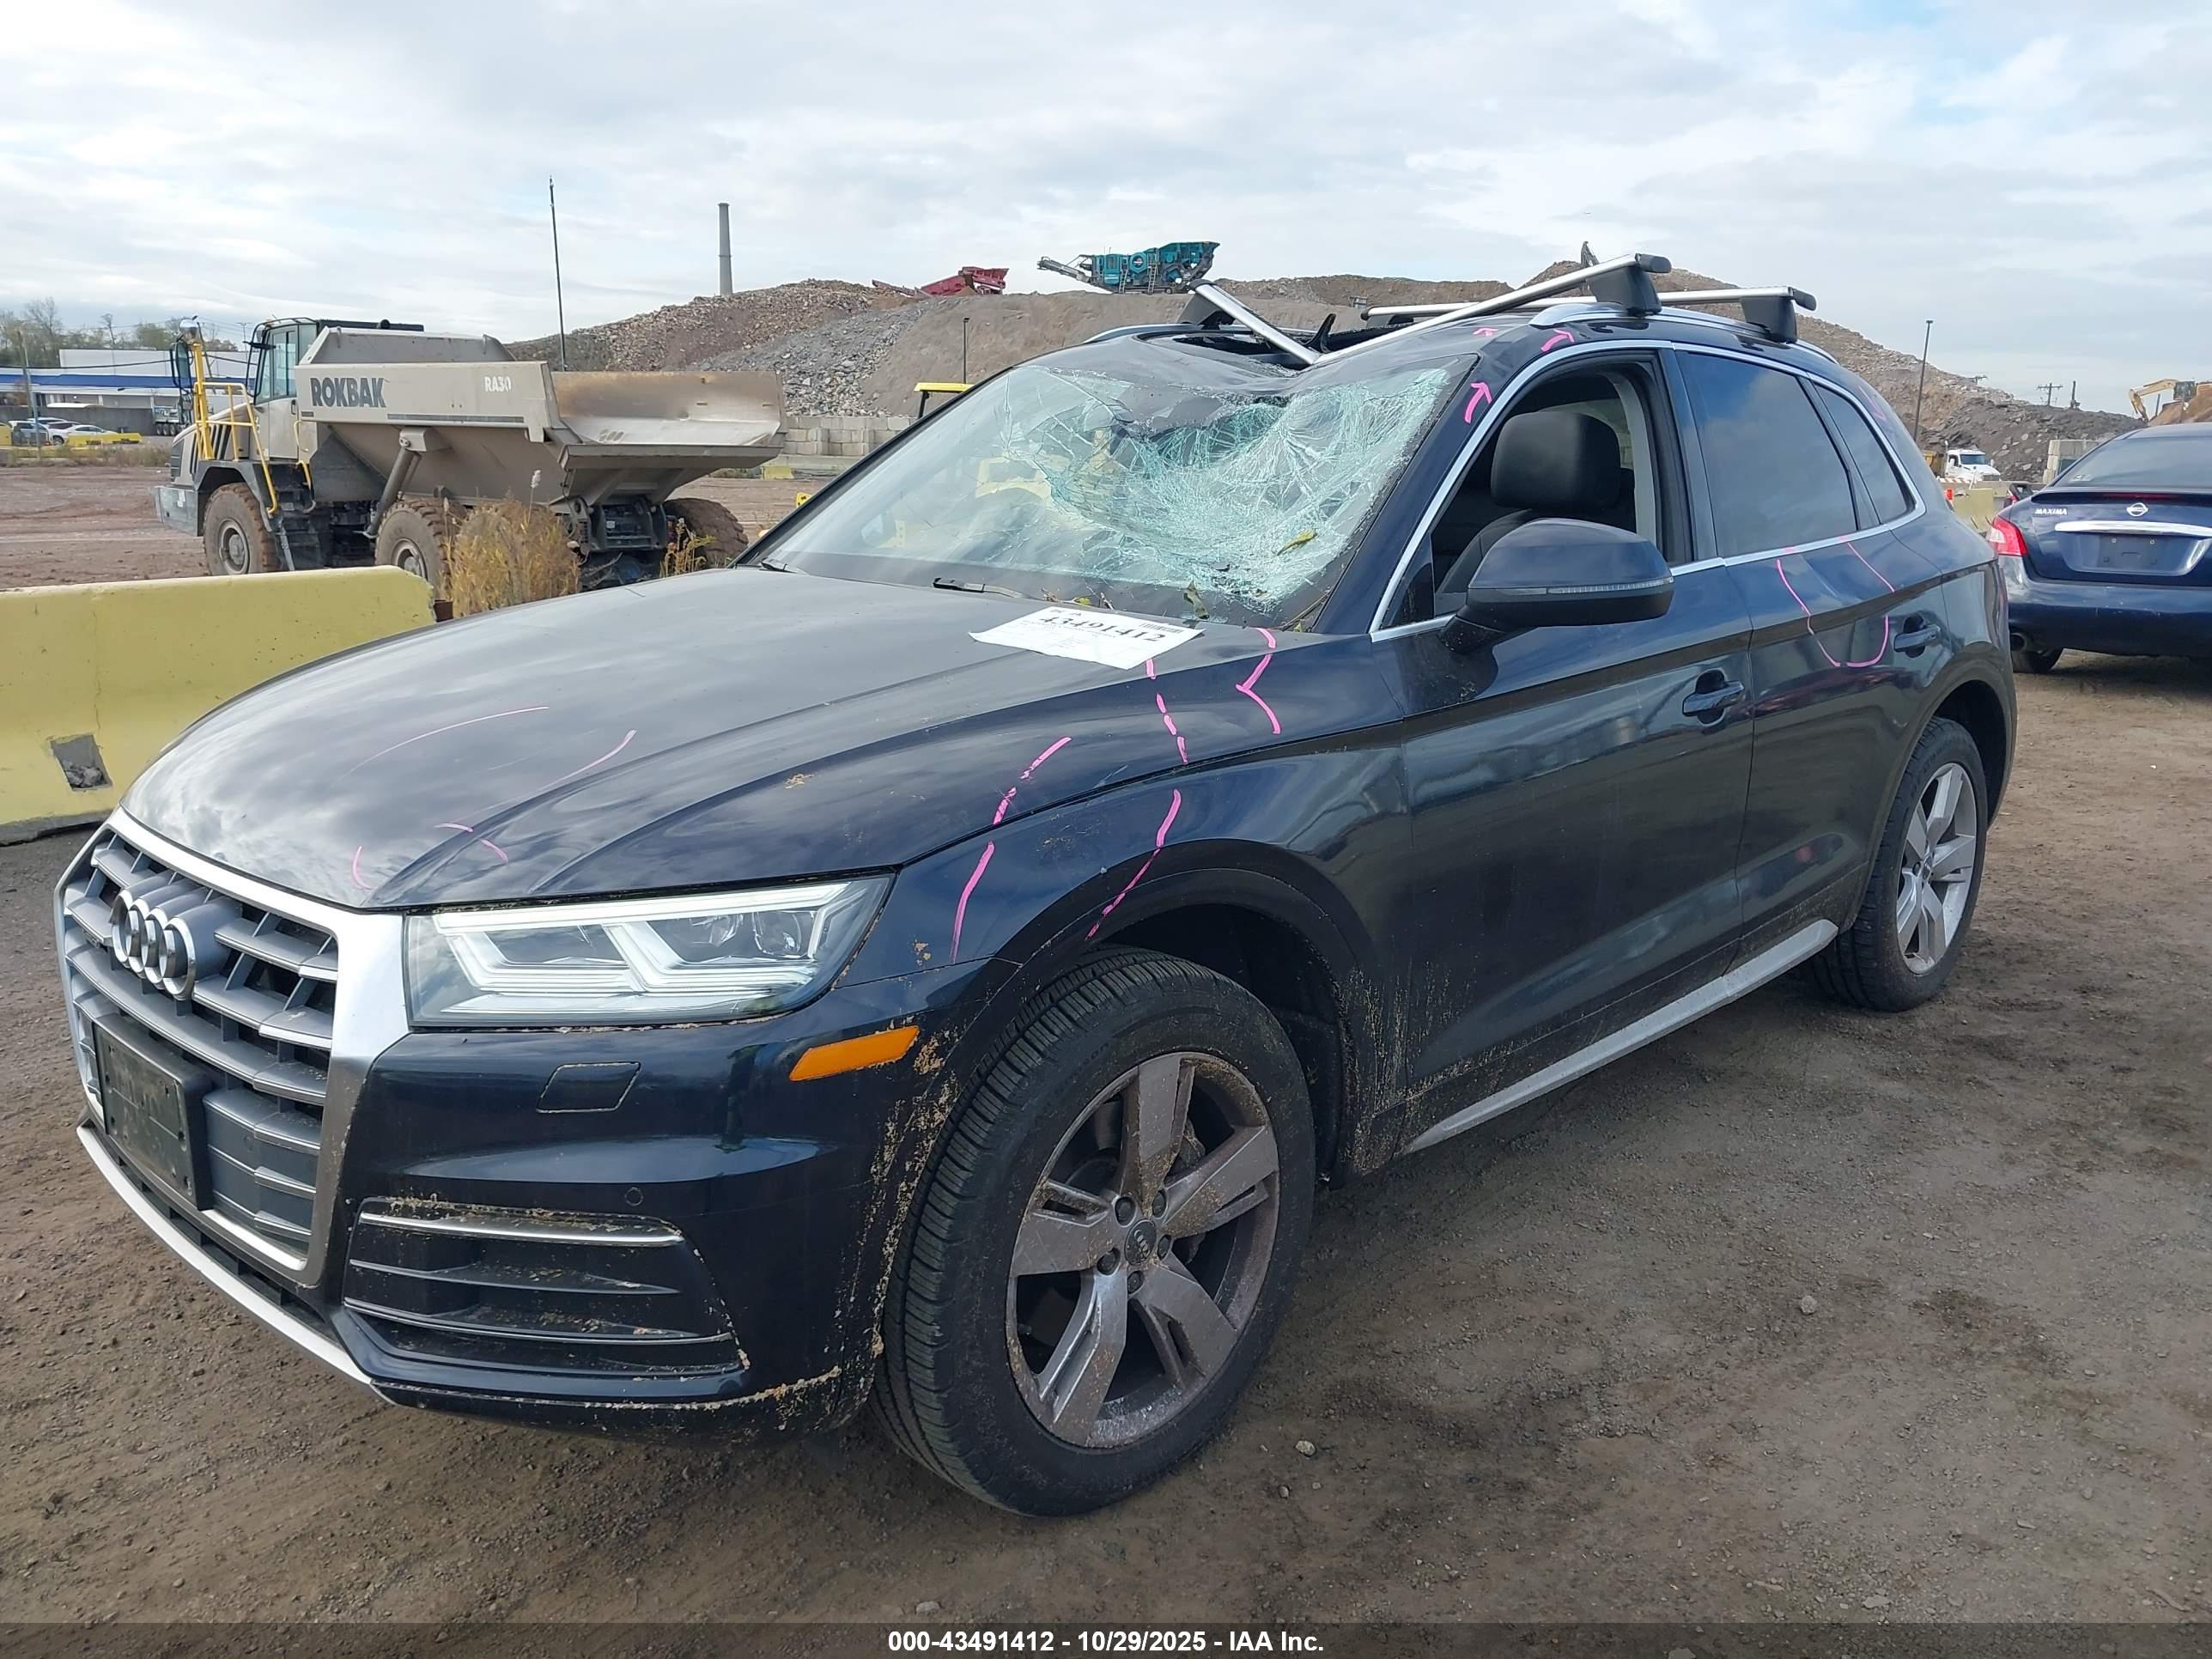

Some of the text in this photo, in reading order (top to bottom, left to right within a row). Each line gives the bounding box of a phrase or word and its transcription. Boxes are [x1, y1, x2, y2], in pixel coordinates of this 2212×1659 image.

[310, 377, 386, 408] ROKBAK
[484, 376, 512, 392] RA30
[2034, 507, 2068, 516] MAXIMA
[1040, 616, 1166, 642] 43491412
